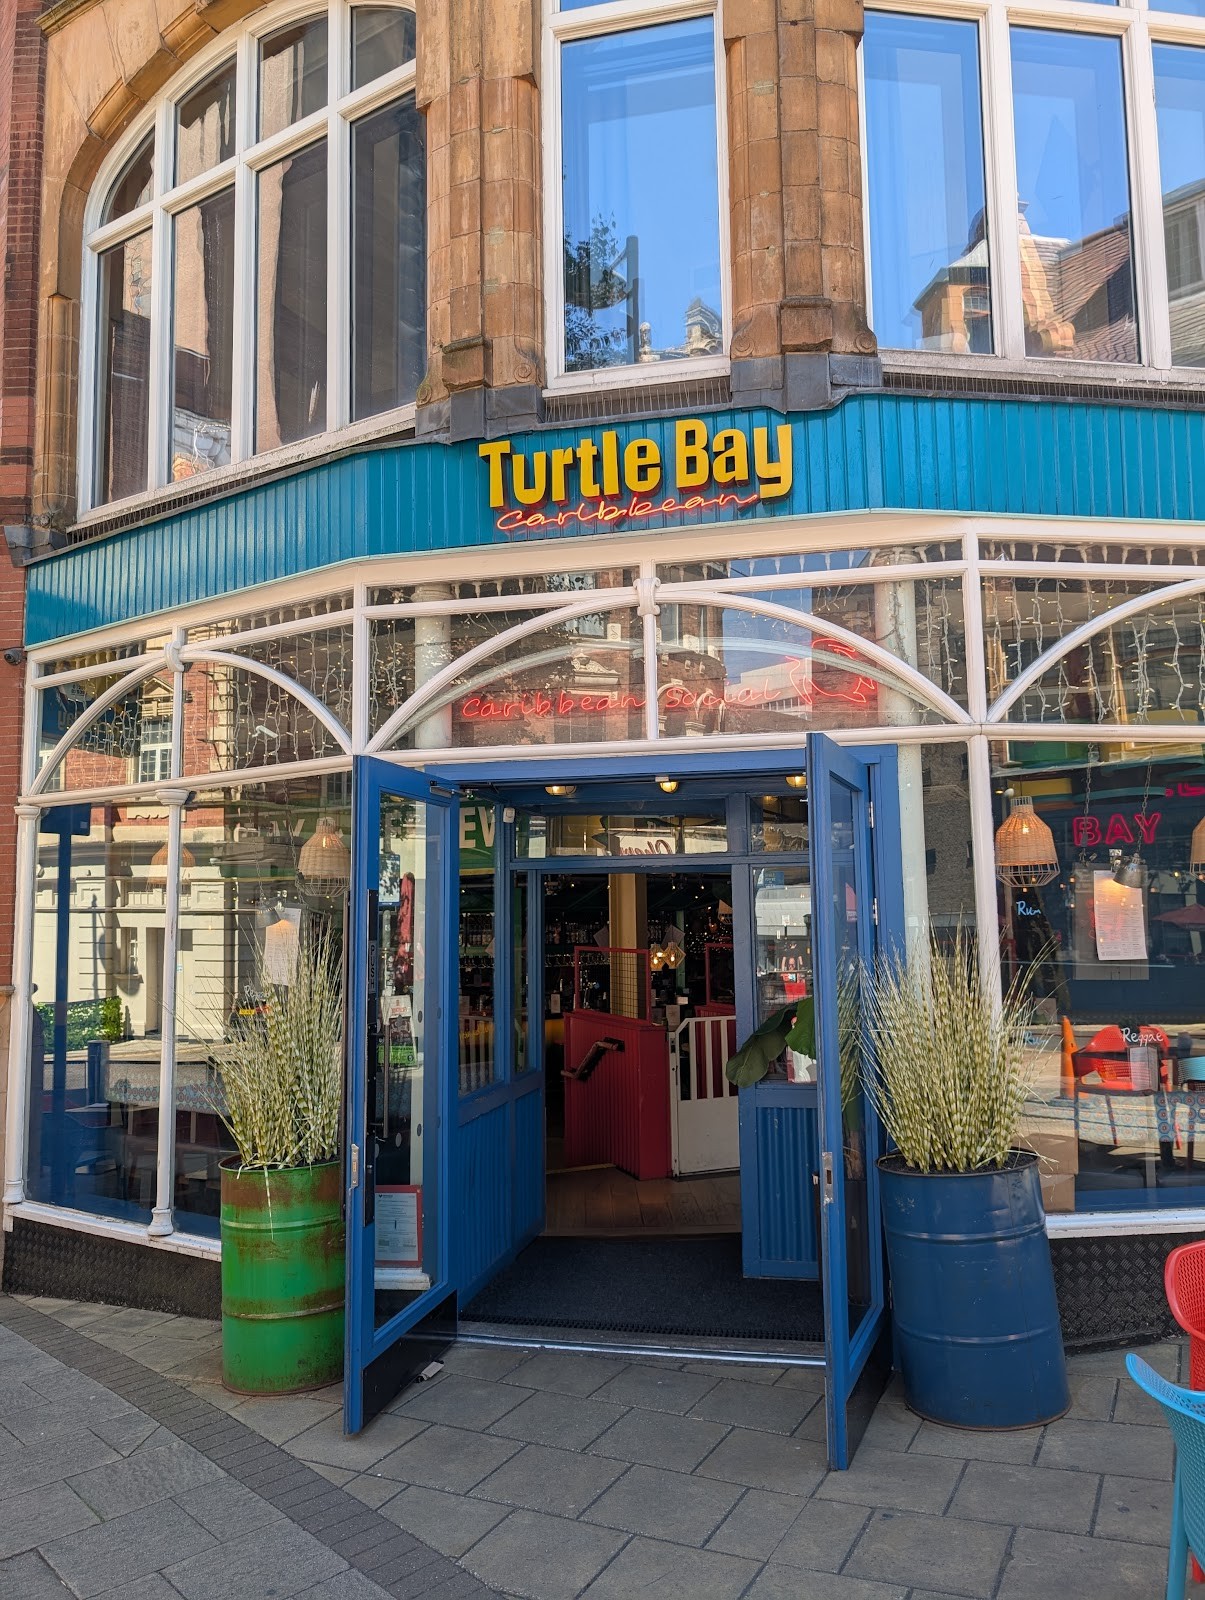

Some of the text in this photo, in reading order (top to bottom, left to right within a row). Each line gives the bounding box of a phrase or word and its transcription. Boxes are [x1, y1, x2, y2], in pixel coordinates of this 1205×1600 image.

[479, 419, 793, 507] Turtle Bay
[1072, 811, 1162, 847] BAY
[1121, 1027, 1163, 1047] Reggae
